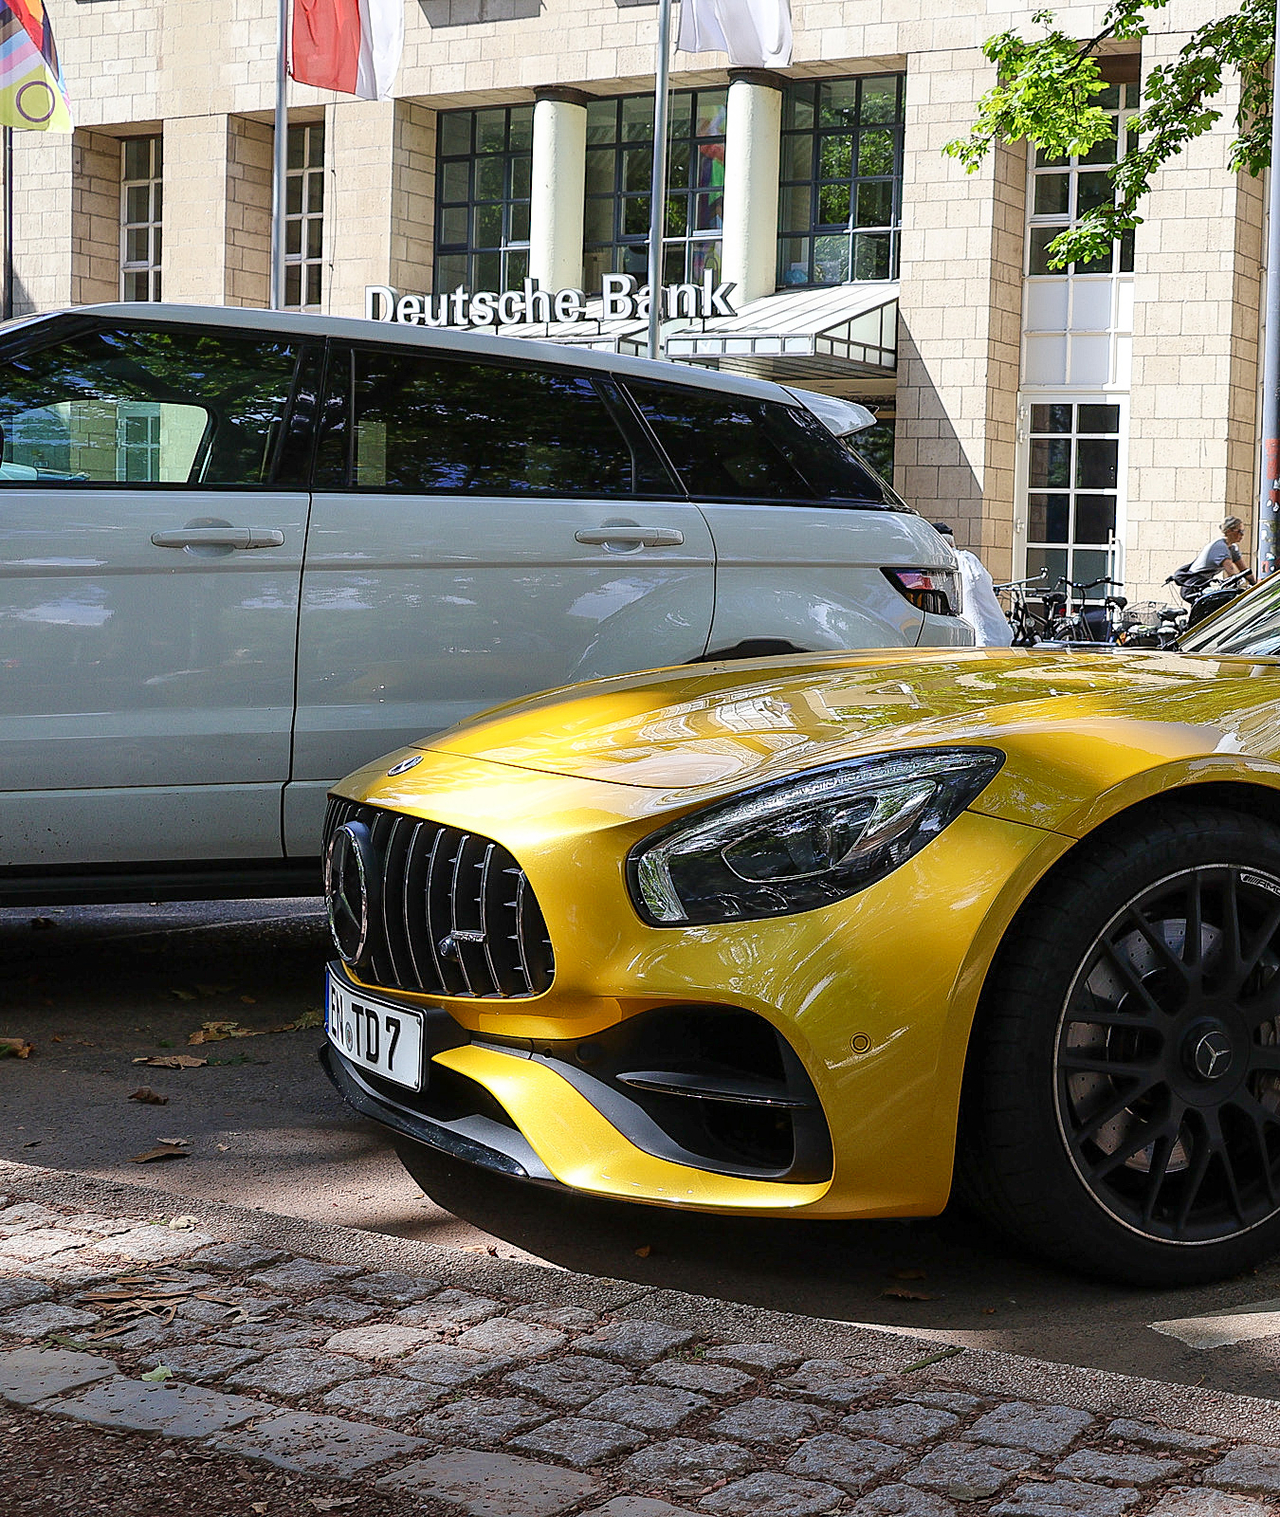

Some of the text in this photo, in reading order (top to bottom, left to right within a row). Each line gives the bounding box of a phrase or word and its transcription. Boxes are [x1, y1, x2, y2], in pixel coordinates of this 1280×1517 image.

[365, 277, 584, 326] Deutsche
[351, 1001, 380, 1064] TD
[385, 1015, 401, 1071] 7
